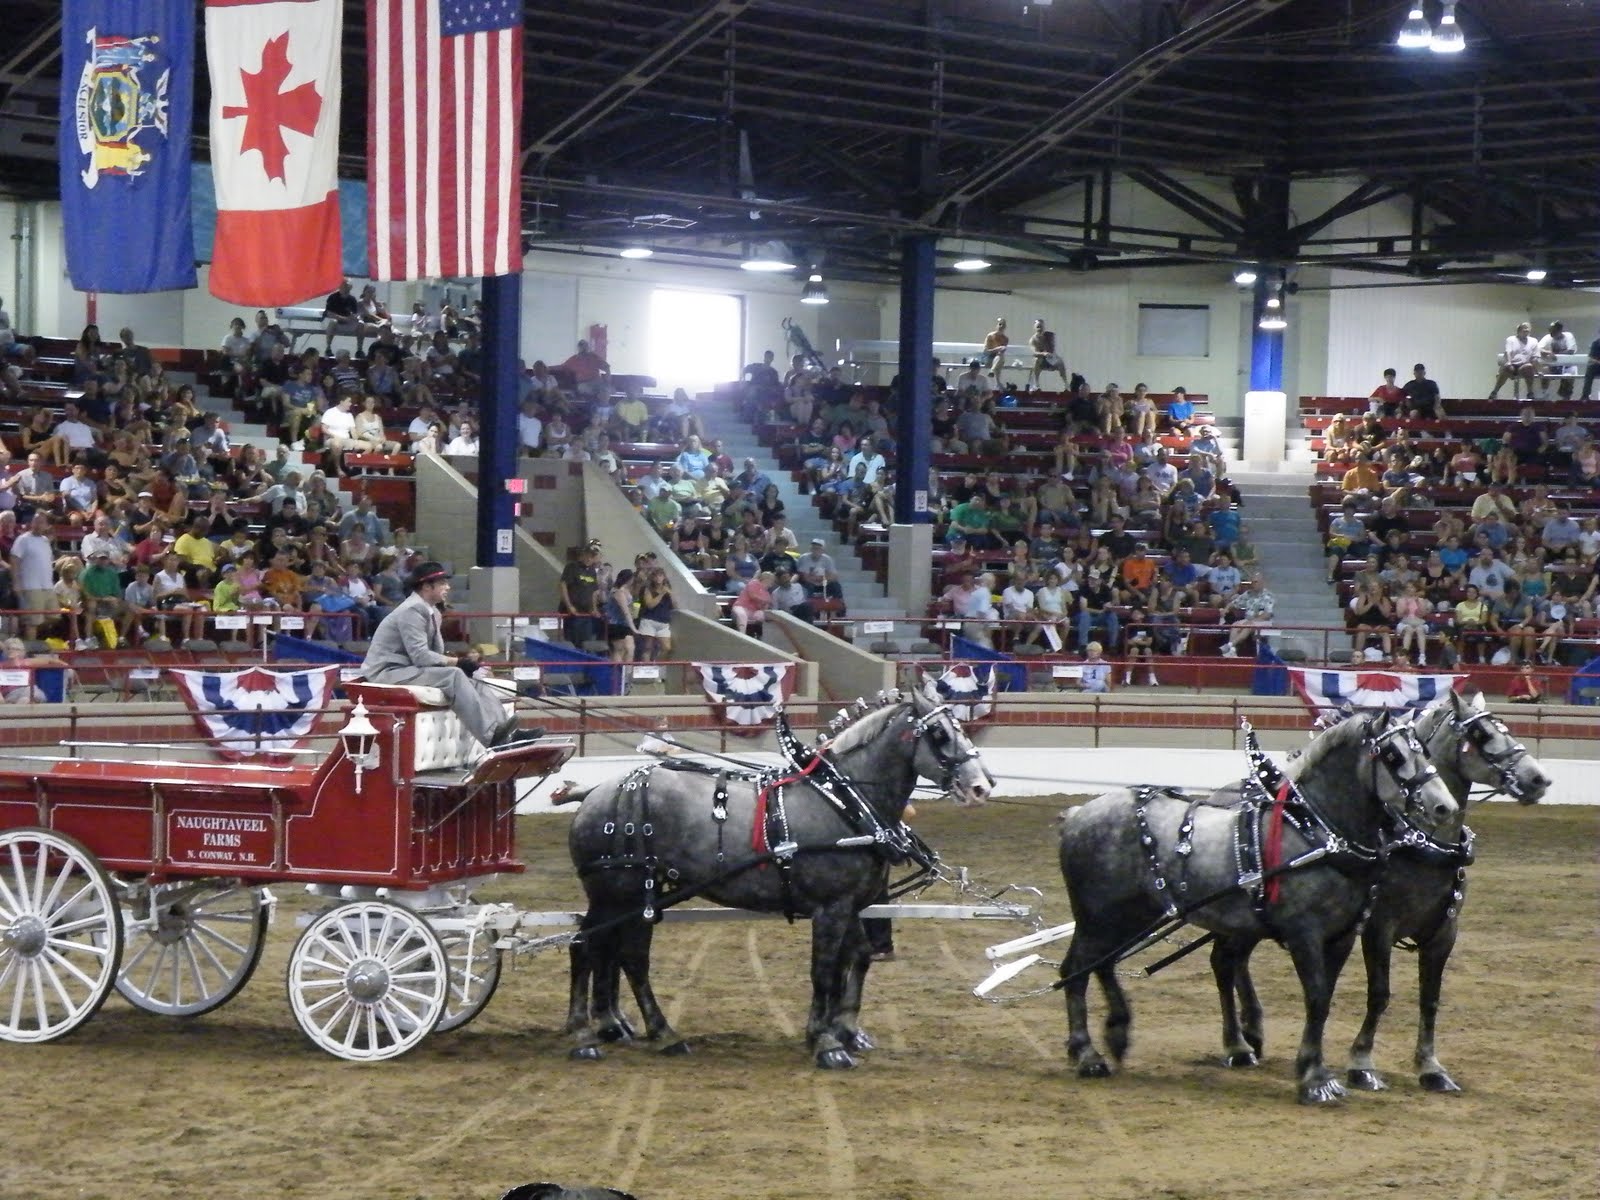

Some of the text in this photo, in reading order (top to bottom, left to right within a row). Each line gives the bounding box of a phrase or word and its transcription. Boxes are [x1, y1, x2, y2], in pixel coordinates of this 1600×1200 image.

[78, 73, 89, 140] XCELSIOR
[177, 816, 267, 832] NAUGHTAVEEL
[203, 833, 241, 847] FARMS
[187, 850, 196, 859] N.
[239, 853, 257, 862] N.H.
